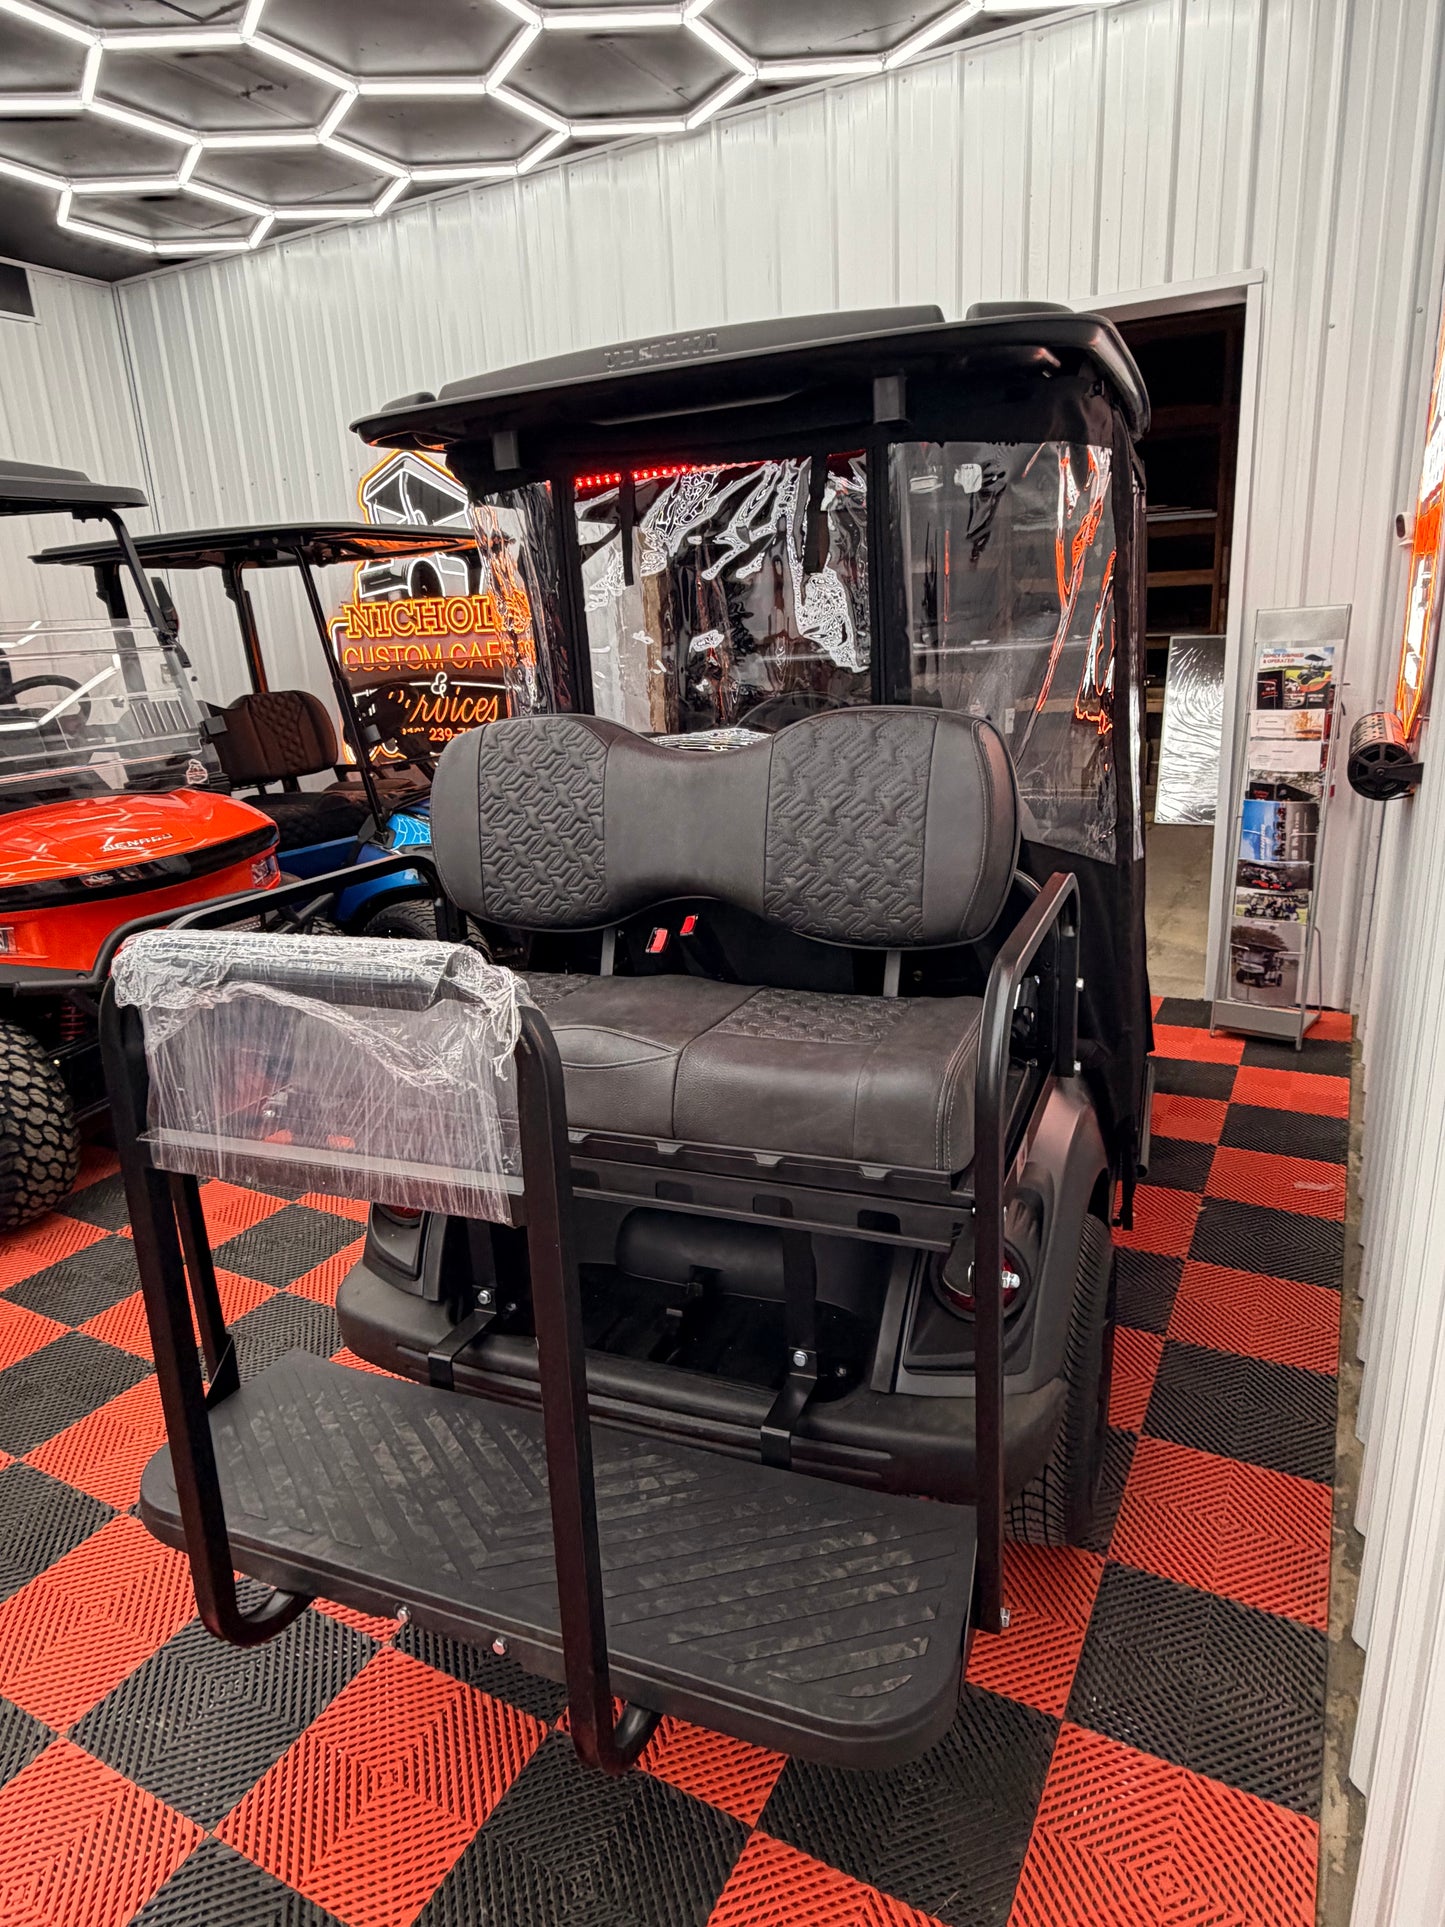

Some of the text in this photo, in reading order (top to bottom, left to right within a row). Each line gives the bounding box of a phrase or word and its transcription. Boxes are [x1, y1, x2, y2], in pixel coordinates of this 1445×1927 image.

[344, 643, 444, 671] CUSTOM
[431, 671, 448, 698] &
[388, 686, 499, 723] rvices
[429, 728, 474, 742] 239-7
